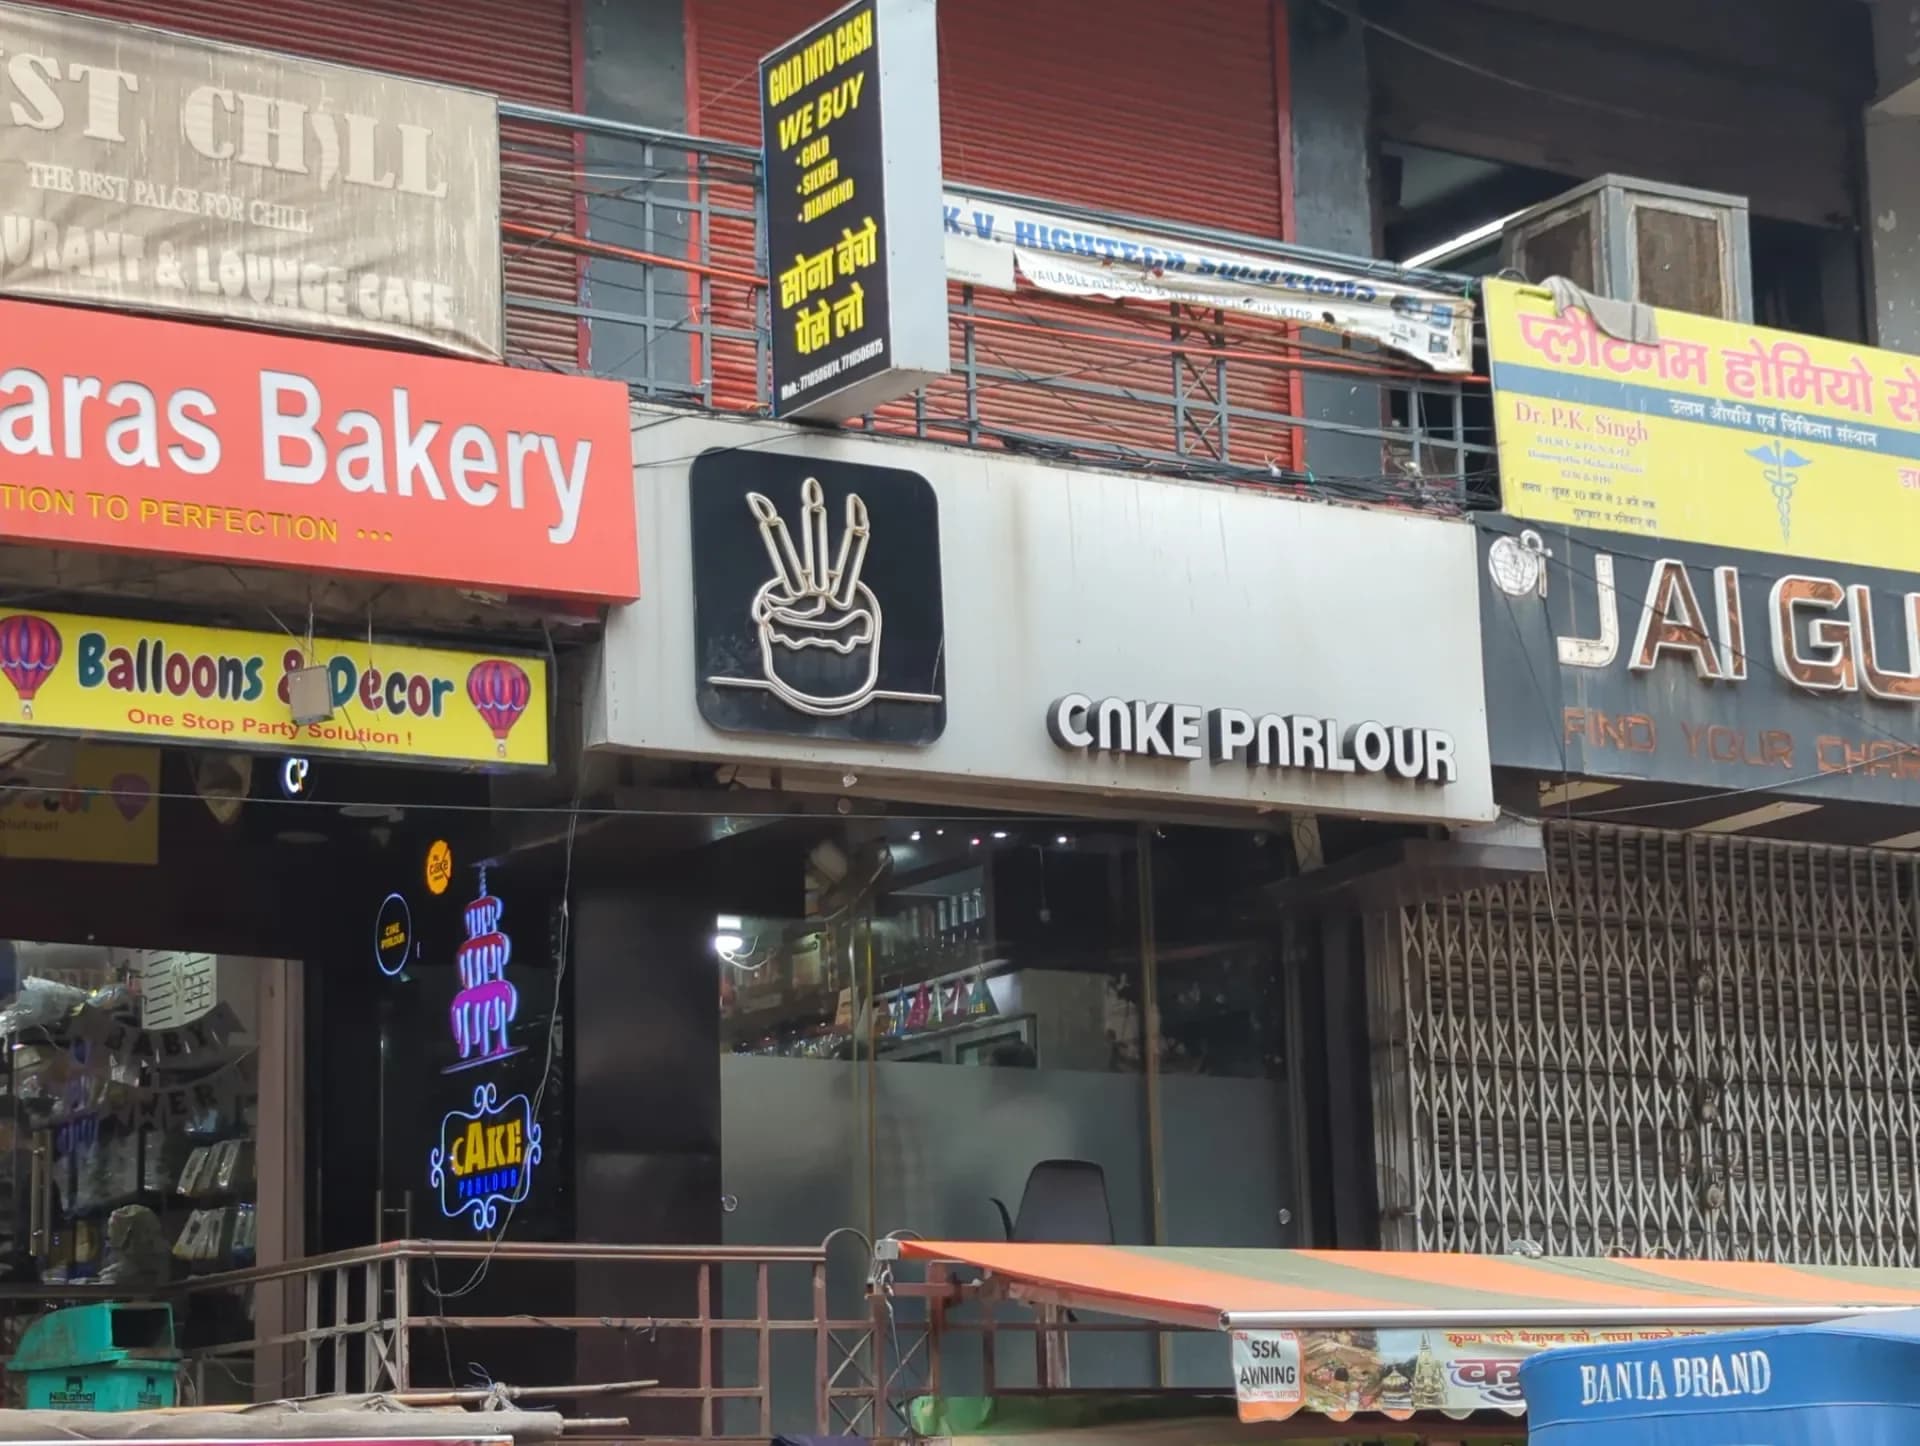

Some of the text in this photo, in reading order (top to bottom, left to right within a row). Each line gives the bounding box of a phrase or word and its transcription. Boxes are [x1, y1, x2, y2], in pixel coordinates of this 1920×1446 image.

[769, 8, 872, 107] GOLD INTO CASH
[0, 48, 139, 142] ST
[779, 71, 864, 152] WE BUY
[802, 134, 829, 168] GOLD
[803, 157, 838, 195] SILVER
[26, 162, 313, 233] THE BEST PALCE FOR CHILL
[803, 177, 854, 223] DIAMOND
[155, 240, 187, 290] &
[779, 216, 877, 309] सोना बेचो
[795, 281, 864, 355] पैसे लो
[1721, 338, 1874, 416] होमियो
[0, 366, 591, 544] aras Bakery
[1516, 401, 1545, 424] Dr.
[1552, 407, 1591, 432] P.K.
[1595, 414, 1648, 447] Singh
[0, 484, 75, 517] TION
[90, 491, 128, 523] TO
[141, 498, 338, 544] PERFECTION
[1557, 554, 1747, 680] JAI
[78, 632, 263, 702] Balloons
[328, 655, 454, 719] Decor
[127, 708, 174, 727] One
[183, 712, 234, 734] Stop
[242, 718, 299, 740] Party
[308, 723, 399, 745] Solution
[1050, 692, 1457, 784] CAKE PARLOUR
[1564, 707, 1656, 754] FIND
[1683, 720, 1794, 770] YOUR
[1240, 1365, 1296, 1385] AWNING
[1252, 1340, 1281, 1359] SSK
[1672, 1350, 1772, 1398] BRAND
